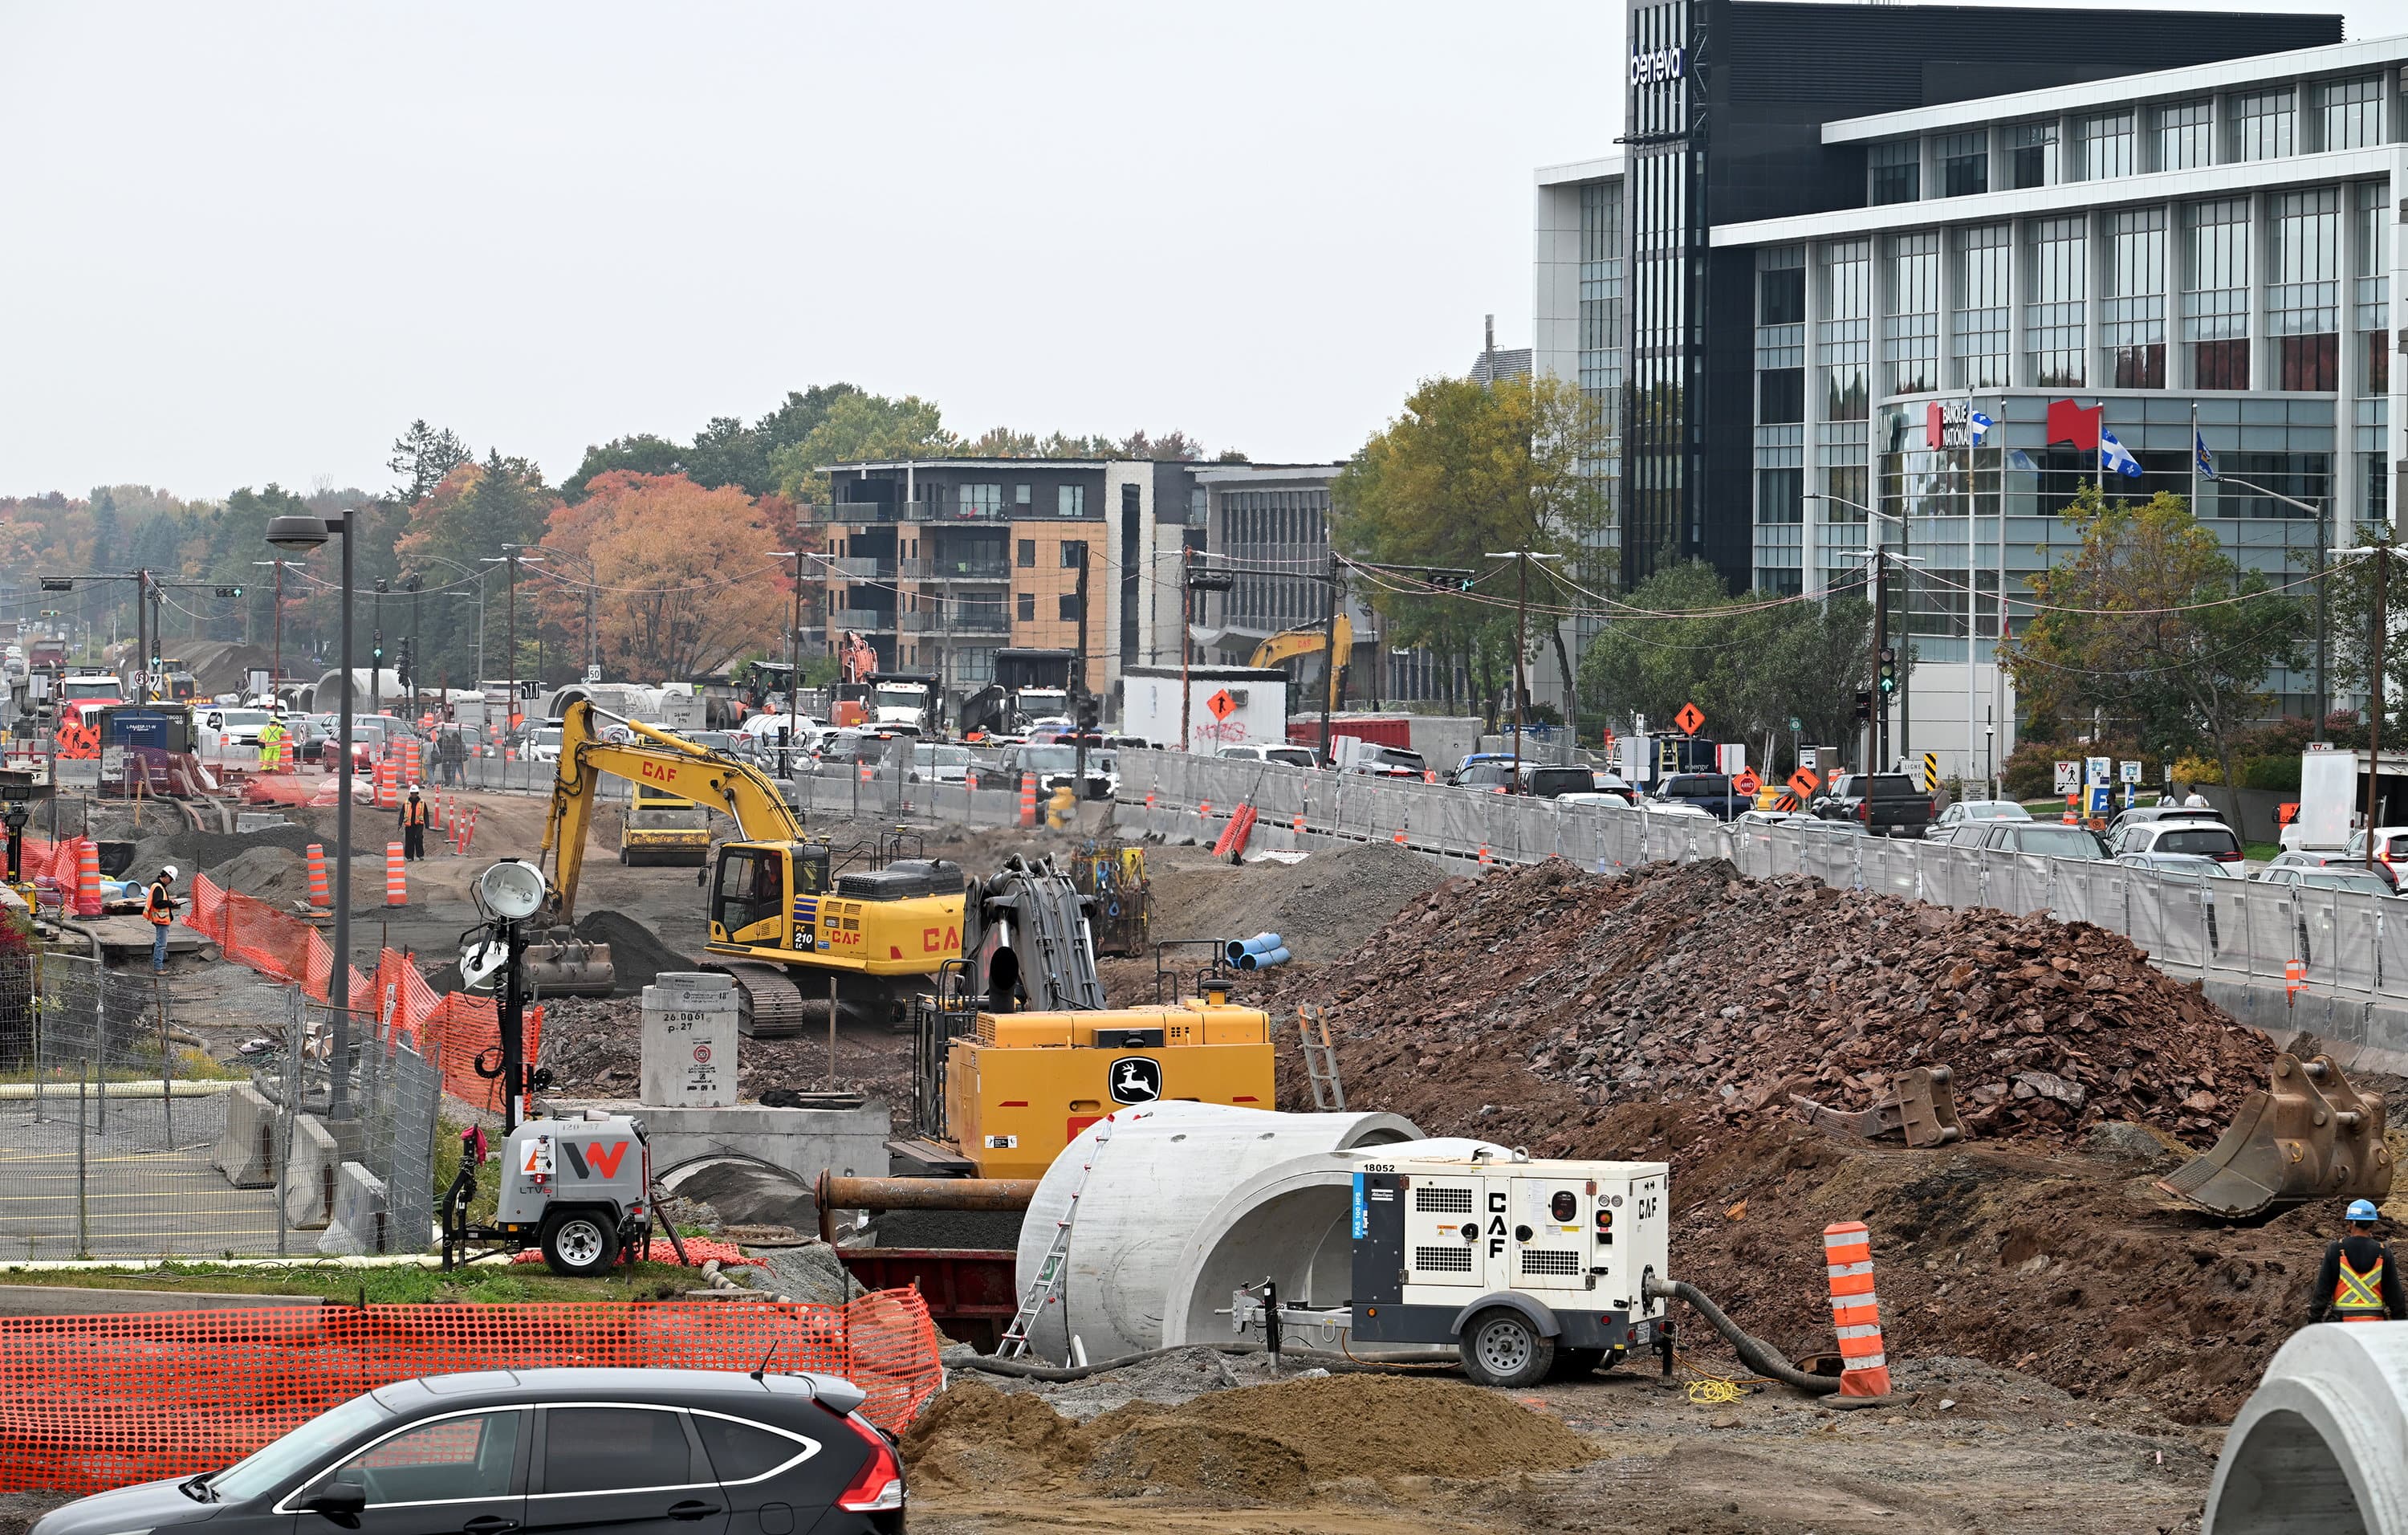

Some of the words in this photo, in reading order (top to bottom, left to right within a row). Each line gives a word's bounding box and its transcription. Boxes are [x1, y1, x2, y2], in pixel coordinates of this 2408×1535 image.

[1631, 43, 1680, 86] beneva
[1942, 404, 1967, 424] BANQUE
[1942, 427, 1970, 446] NATIONA
[589, 670, 600, 679] 50
[642, 761, 677, 782] CAF
[795, 933, 813, 944] 210
[832, 930, 860, 944] CAF
[923, 926, 960, 953] CA
[664, 1013, 704, 1021] 26.0061
[1364, 1164, 1395, 1172] 18052
[1638, 1197, 1657, 1219] CAF
[1487, 1192, 1507, 1259] CAF
